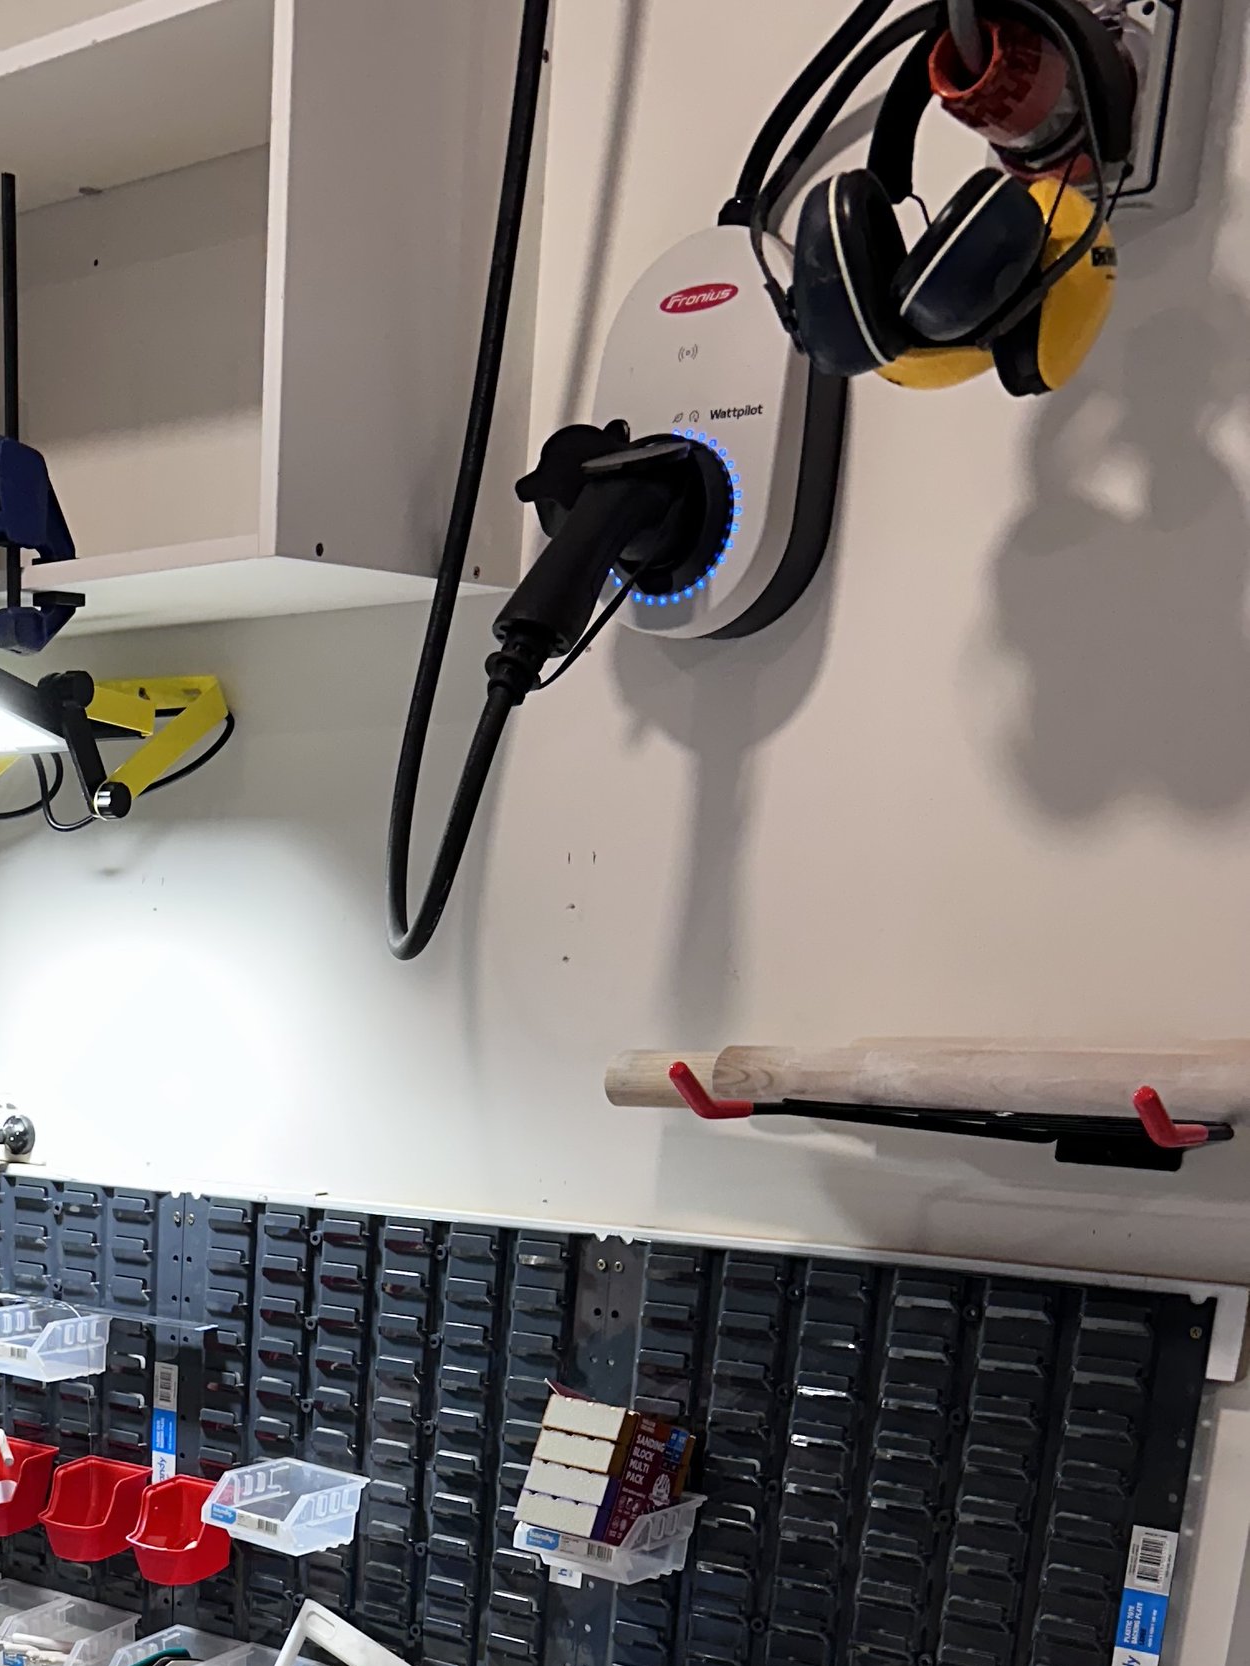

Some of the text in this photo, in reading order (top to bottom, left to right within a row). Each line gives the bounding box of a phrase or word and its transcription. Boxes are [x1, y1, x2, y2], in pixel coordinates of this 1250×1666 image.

[665, 287, 733, 310] Fronius
[710, 404, 763, 420] Wattpilot
[636, 1434, 666, 1453] SANDING
[632, 1446, 655, 1462] BLOCK
[157, 1456, 167, 1482] andy
[629, 1458, 650, 1474] MULTI
[625, 1471, 645, 1485] PACK
